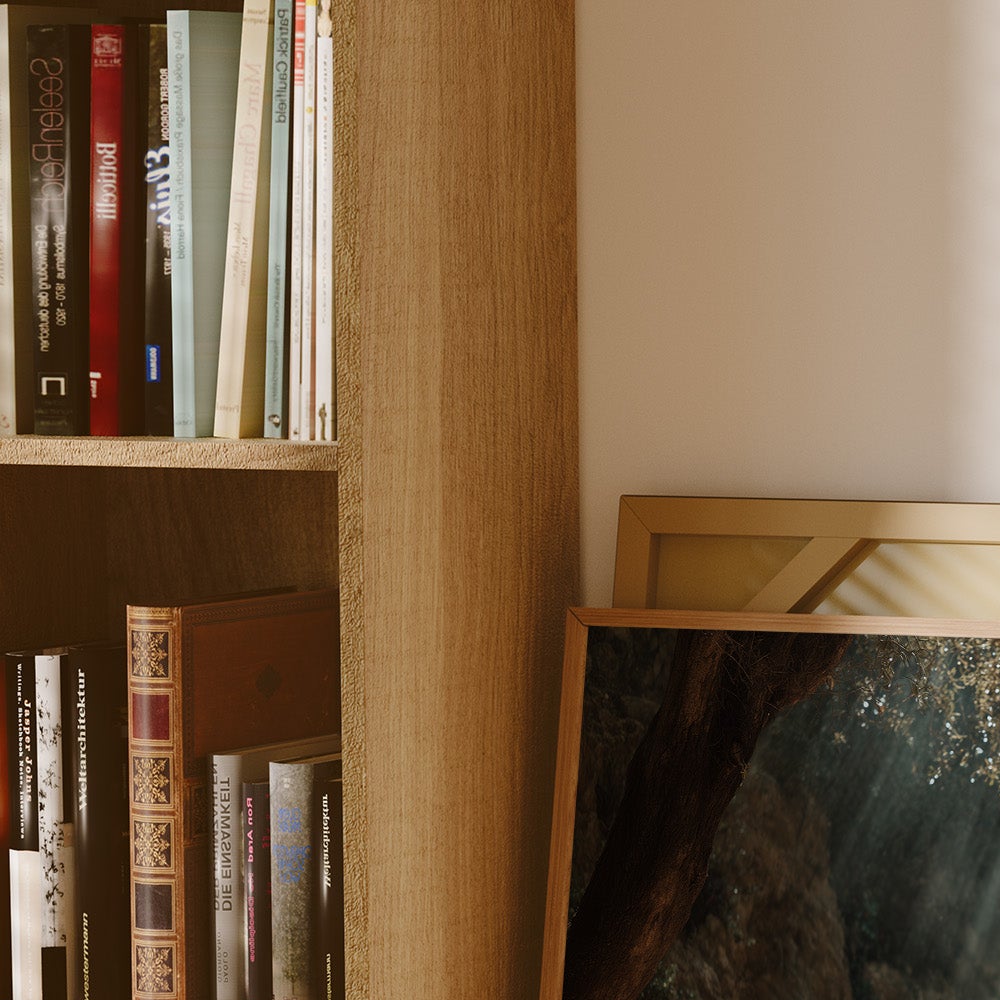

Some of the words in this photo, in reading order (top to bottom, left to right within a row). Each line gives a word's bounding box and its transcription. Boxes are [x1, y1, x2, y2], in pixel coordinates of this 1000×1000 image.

[24, 699, 32, 752] Jasper
[77, 668, 87, 811] Weltarchitektur
[25, 756, 33, 802] Johns
